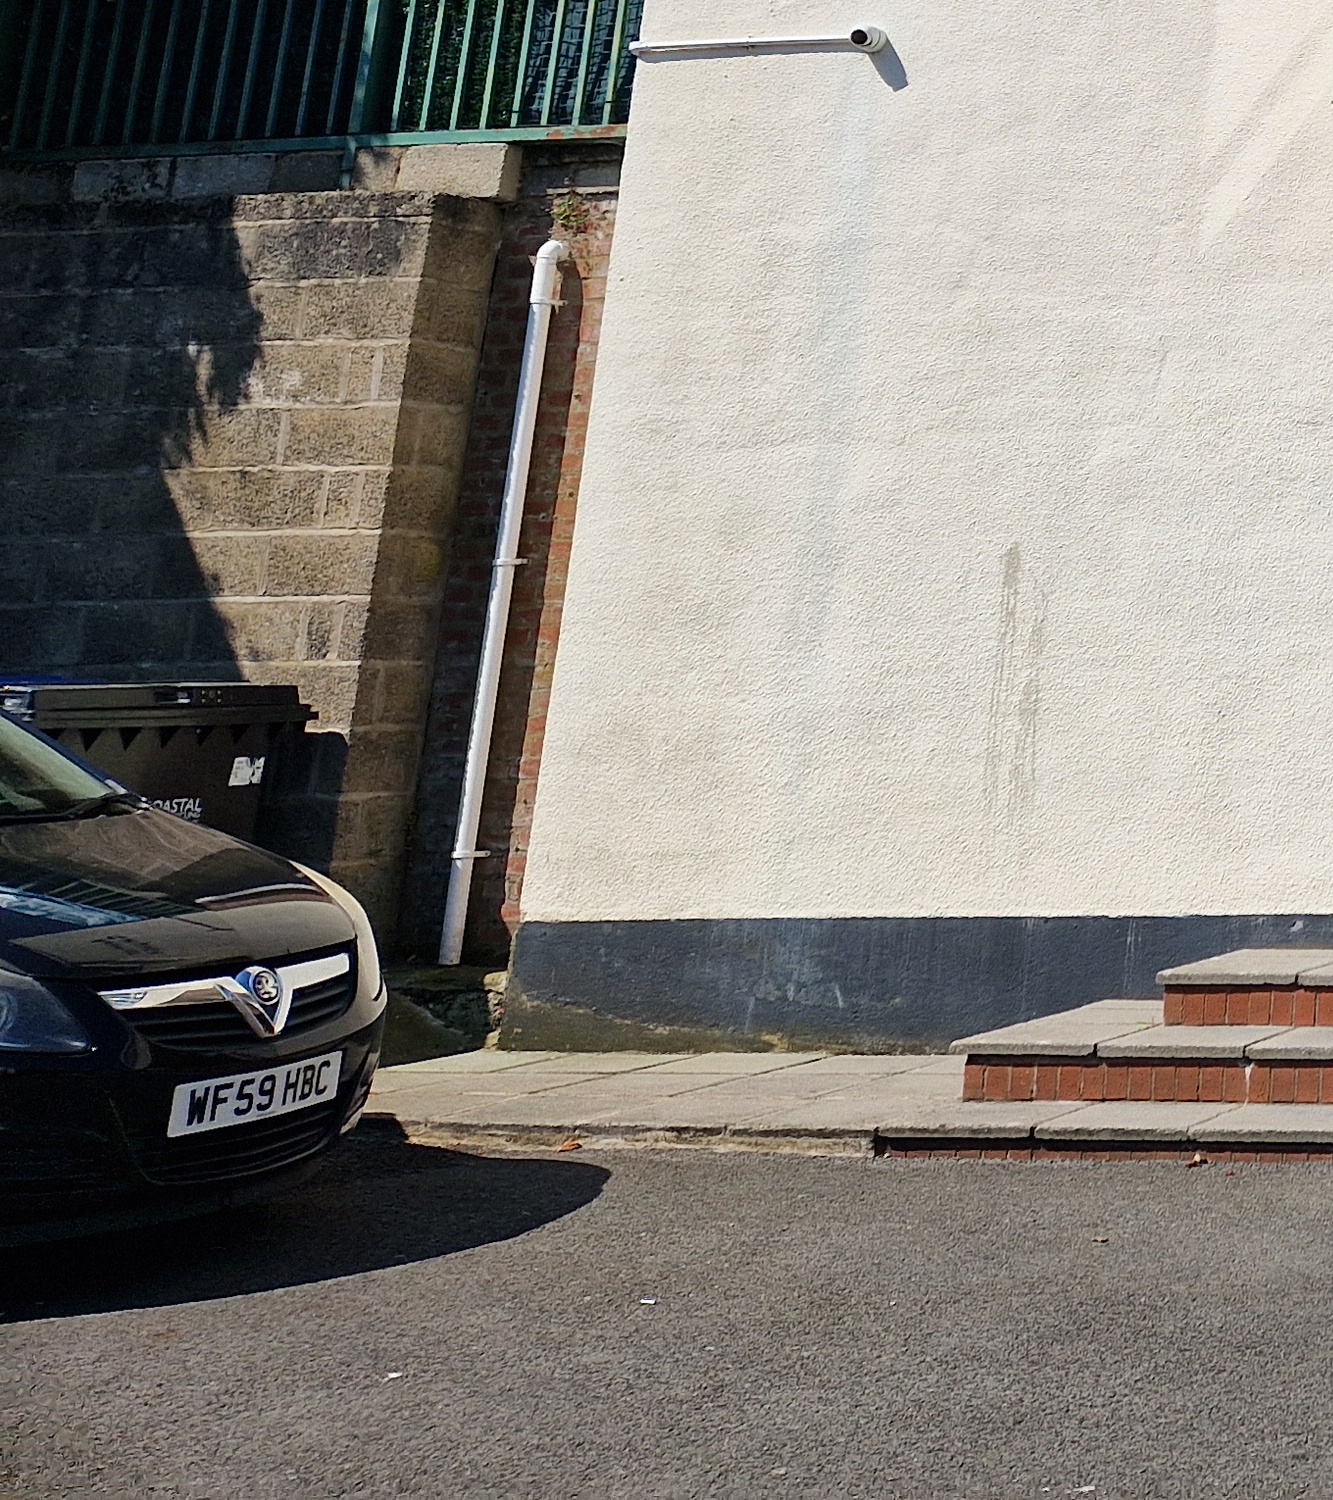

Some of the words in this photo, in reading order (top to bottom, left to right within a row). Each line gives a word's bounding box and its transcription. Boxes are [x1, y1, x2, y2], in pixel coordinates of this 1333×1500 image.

[152, 797, 202, 814] OASTAL
[186, 1074, 277, 1127] WF59
[282, 1060, 331, 1106] HBC
